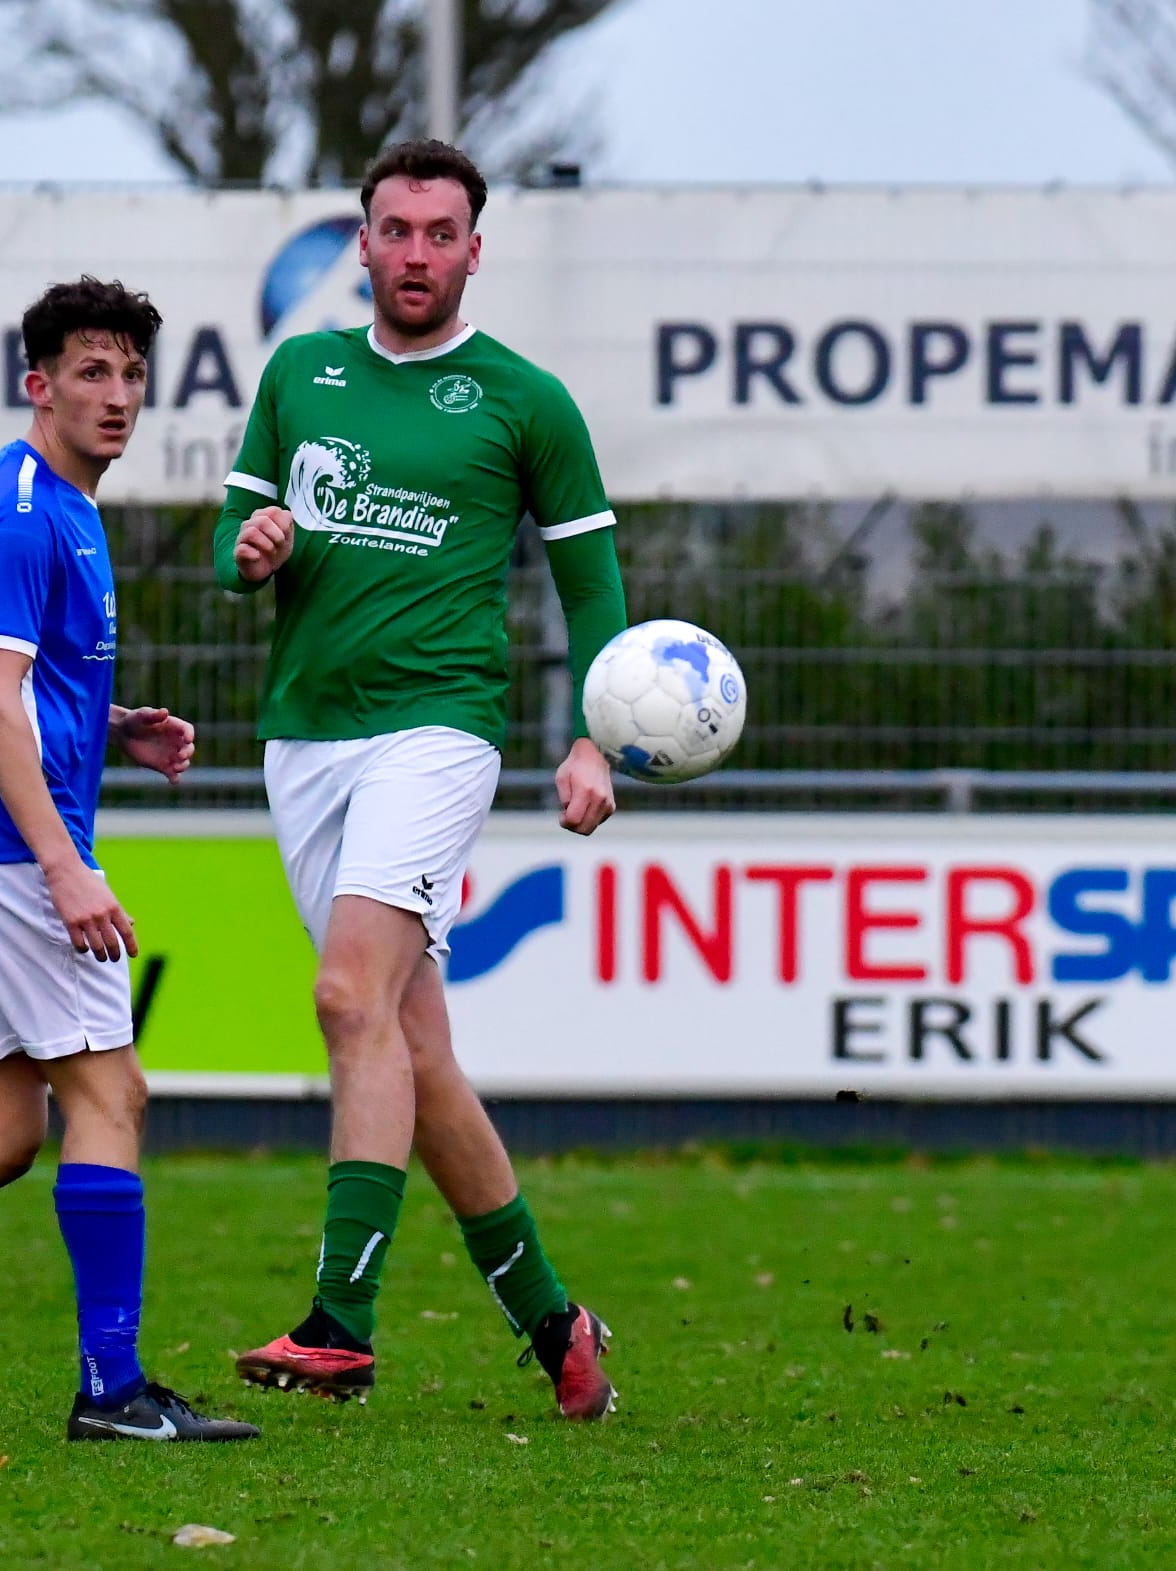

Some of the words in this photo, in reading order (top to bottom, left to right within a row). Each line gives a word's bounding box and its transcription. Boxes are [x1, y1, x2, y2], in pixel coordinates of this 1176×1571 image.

[655, 320, 1176, 406] PROPEM
[313, 377, 346, 387] erima
[365, 483, 450, 509] Strandpaviljoen
[329, 534, 428, 556] Zoutelande
[832, 998, 1108, 1062] ERIK
